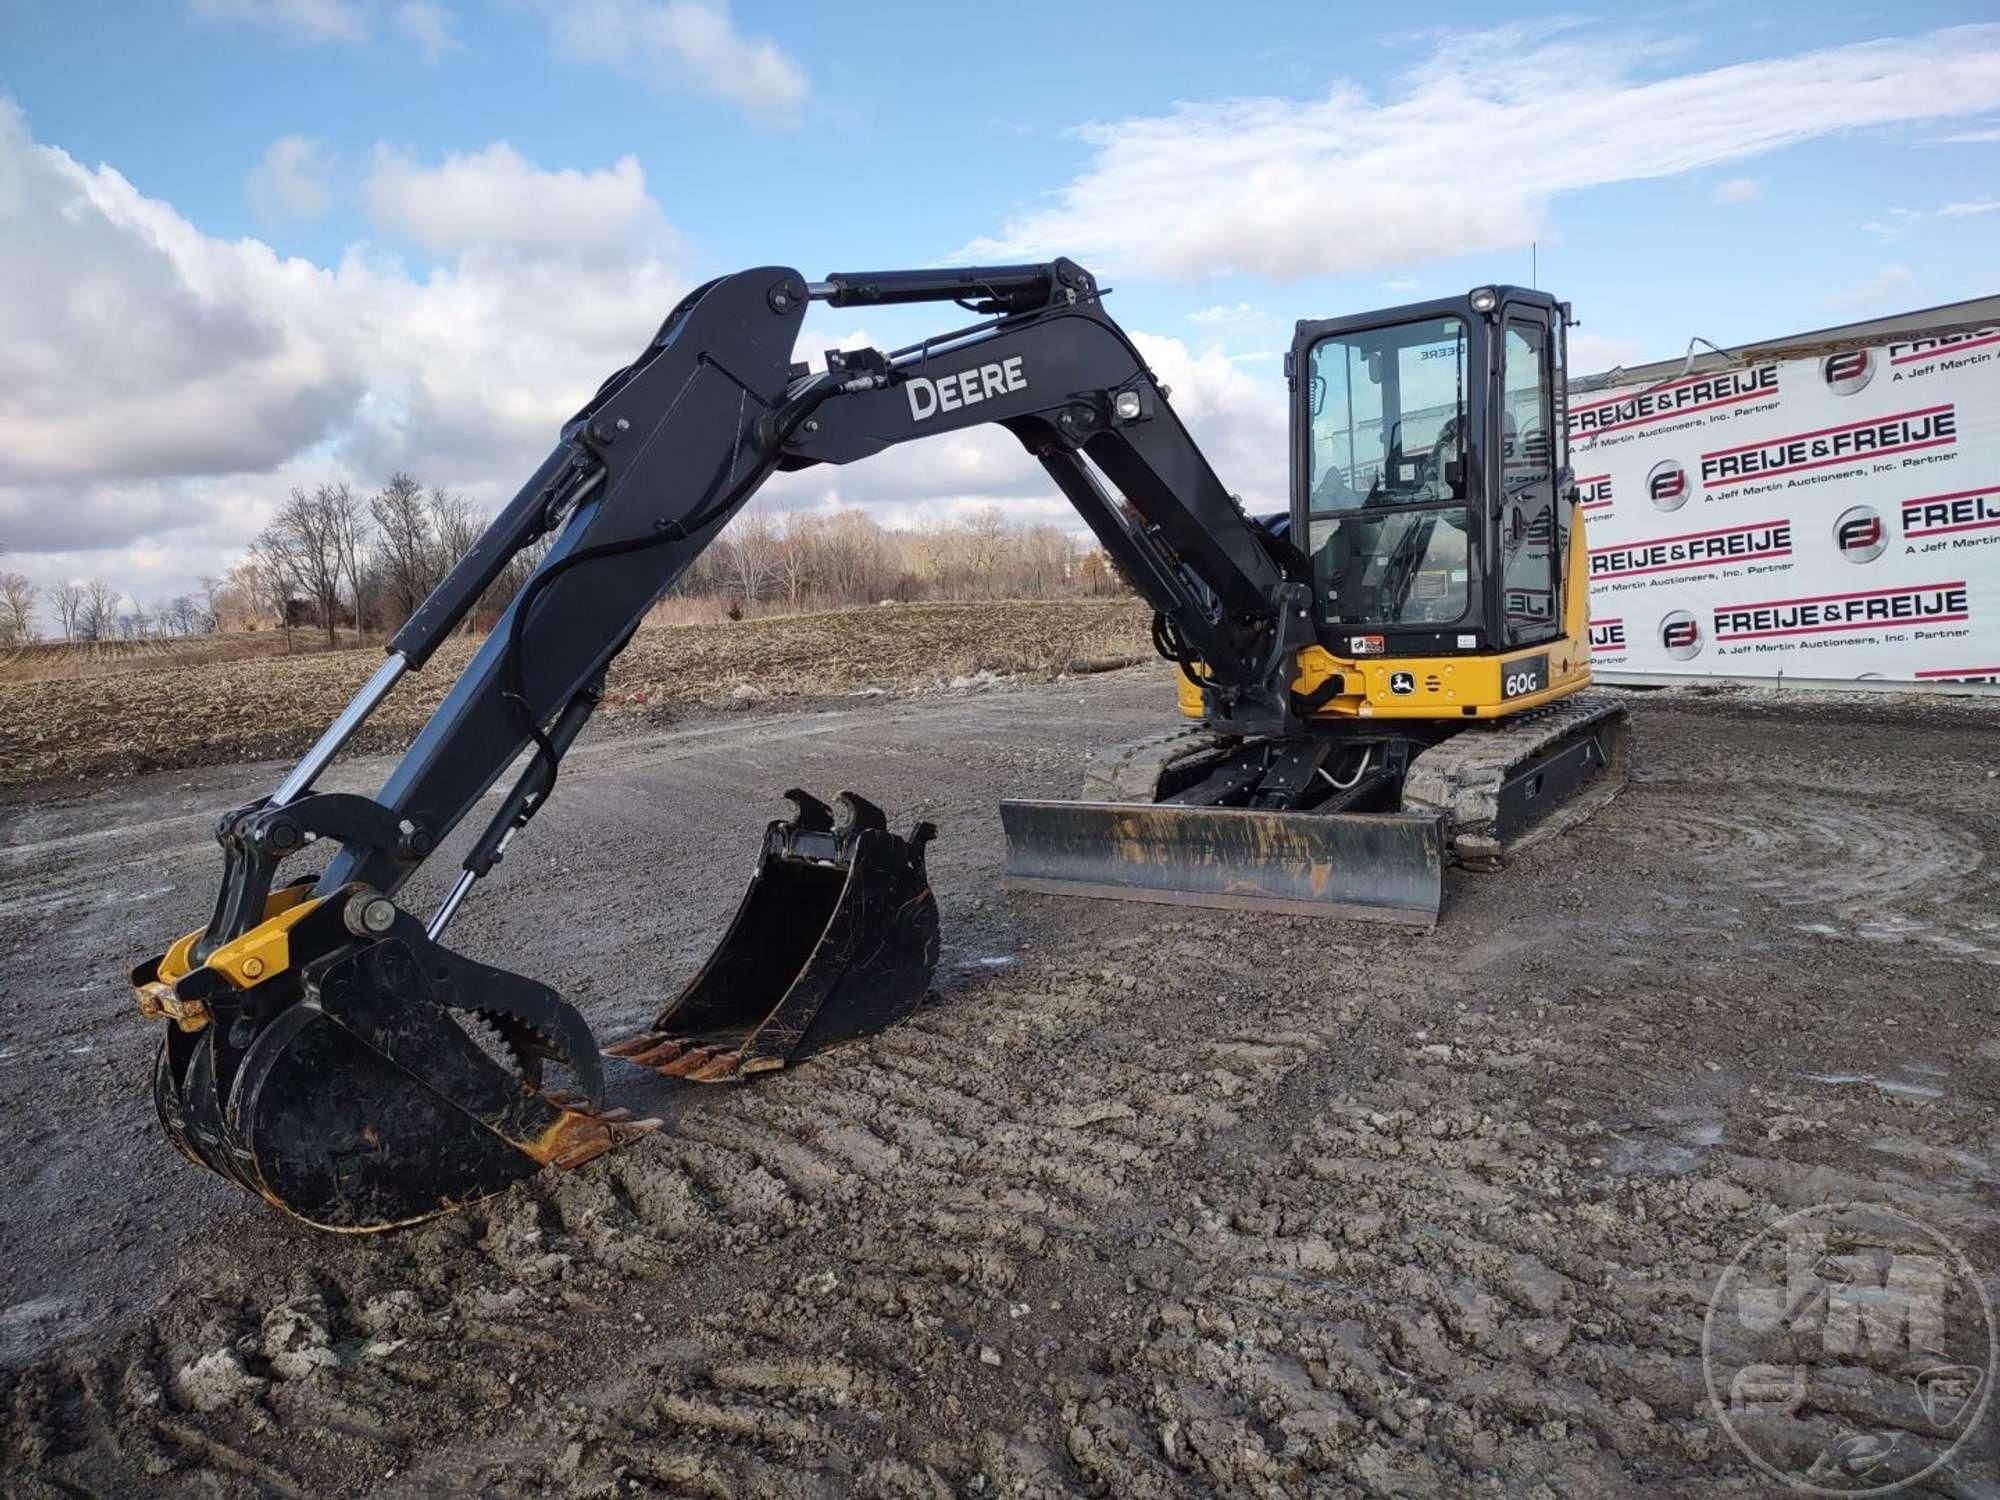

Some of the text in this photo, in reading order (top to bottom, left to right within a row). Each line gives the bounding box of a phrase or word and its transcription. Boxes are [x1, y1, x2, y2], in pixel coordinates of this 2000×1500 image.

[1892, 371, 1903, 382] A
[1908, 363, 1935, 378] Jeff
[1940, 354, 1991, 371] Martin
[905, 356, 1028, 421] DEERE
[1601, 432, 1635, 449] Martin
[1637, 418, 1706, 439] Auctioneers,
[1709, 413, 1731, 423] Inc.
[1734, 401, 1781, 417] Partner
[1704, 450, 1959, 503] A Jeff Martin Auctioneers, Inc. Partner
[1585, 513, 1615, 523] artner
[1905, 535, 2000, 555] A Jeff Martin
[1591, 546, 1667, 574] REIJE
[1590, 563, 1794, 595] Jeff Martin Auctioneers, Inc. Partner
[1717, 628, 1970, 656] A Jeff Martin Auctioneers, Inc. Partner
[1505, 672, 1537, 698] 60G
